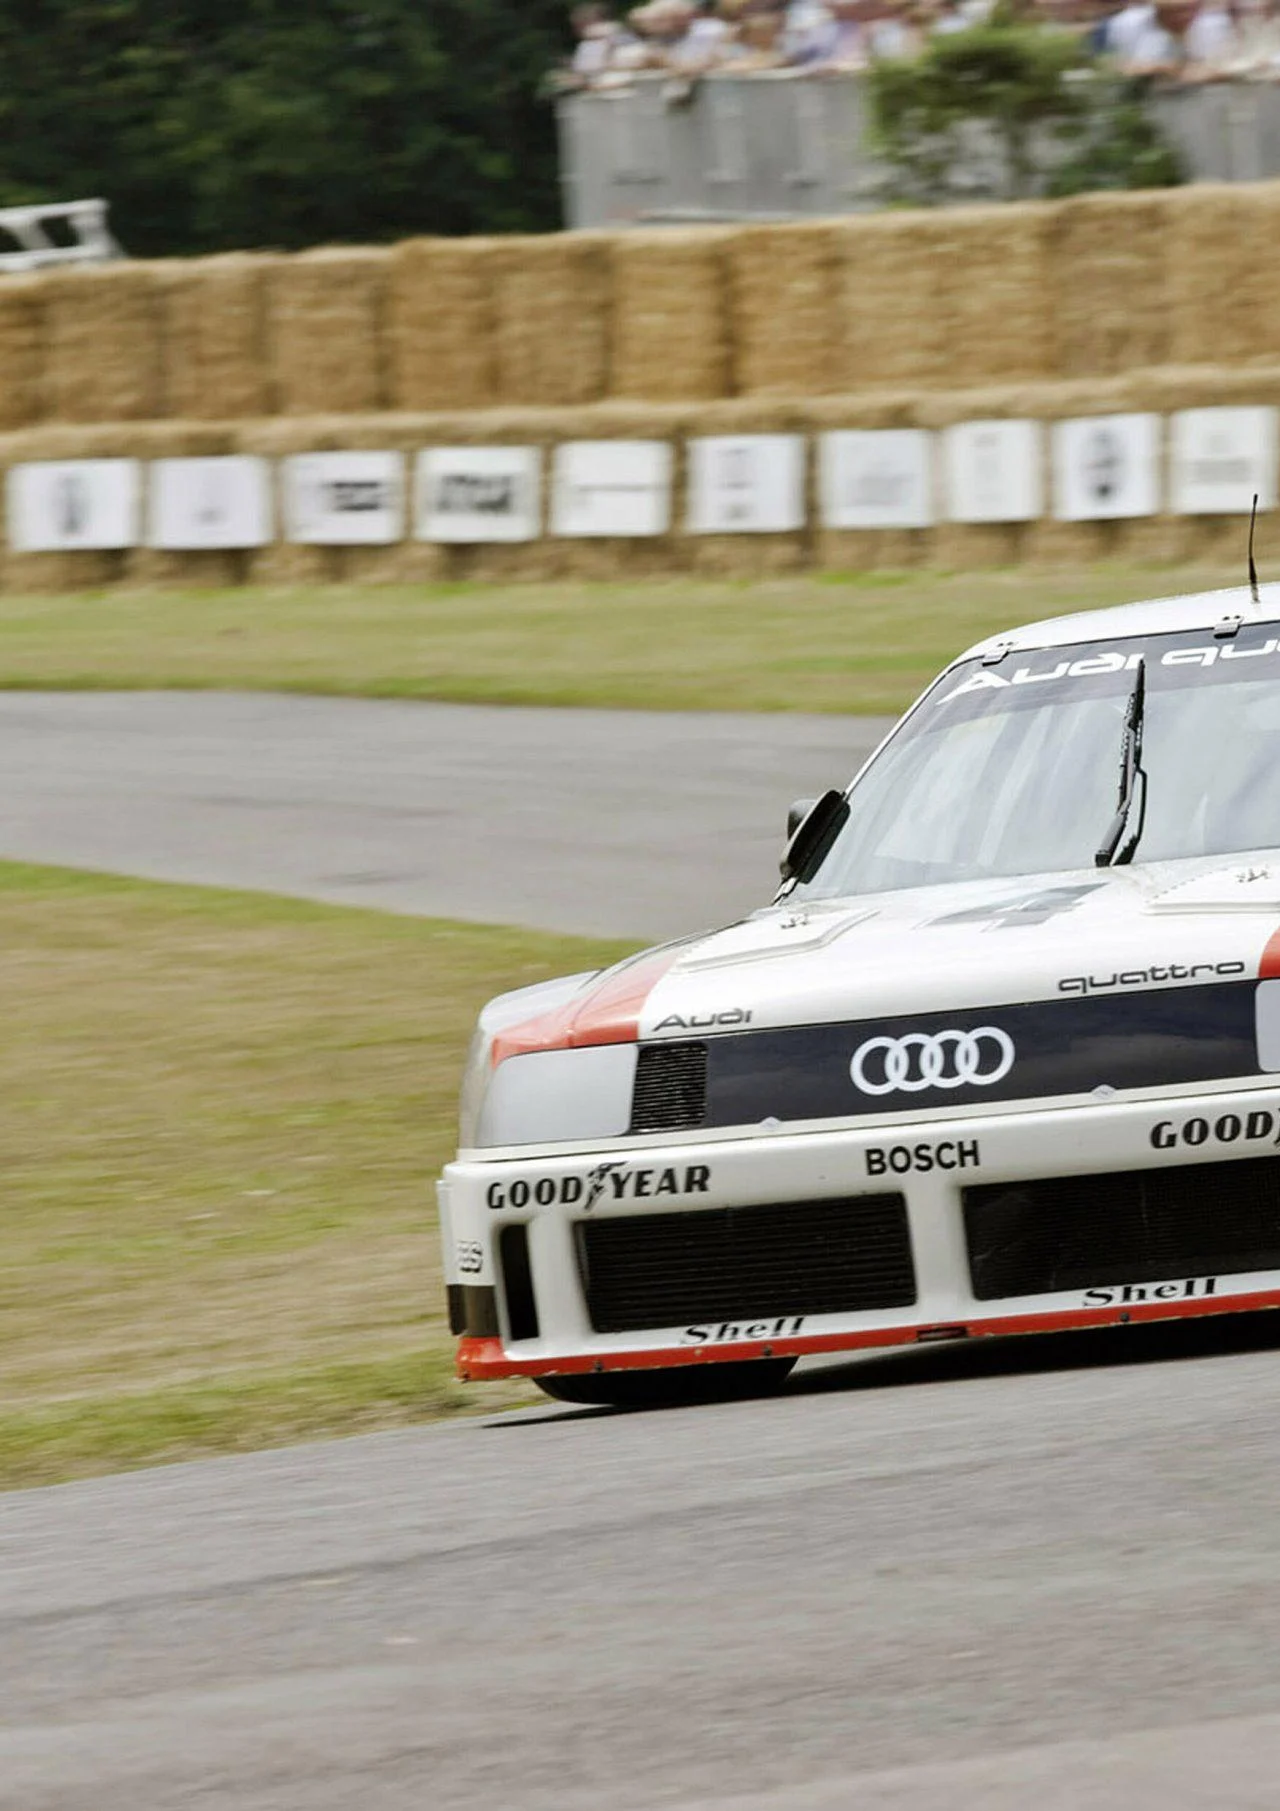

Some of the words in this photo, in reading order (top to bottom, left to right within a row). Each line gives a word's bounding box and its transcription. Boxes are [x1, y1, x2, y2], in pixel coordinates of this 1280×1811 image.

[935, 652, 1144, 705] Audi
[653, 1009, 753, 1032] Audi
[1058, 960, 1246, 993] quattro
[865, 1139, 980, 1176] BOSCH
[486, 1161, 712, 1211] GOODYEAR
[1082, 1278, 1217, 1308] Shell
[679, 1317, 805, 1346] Shell
